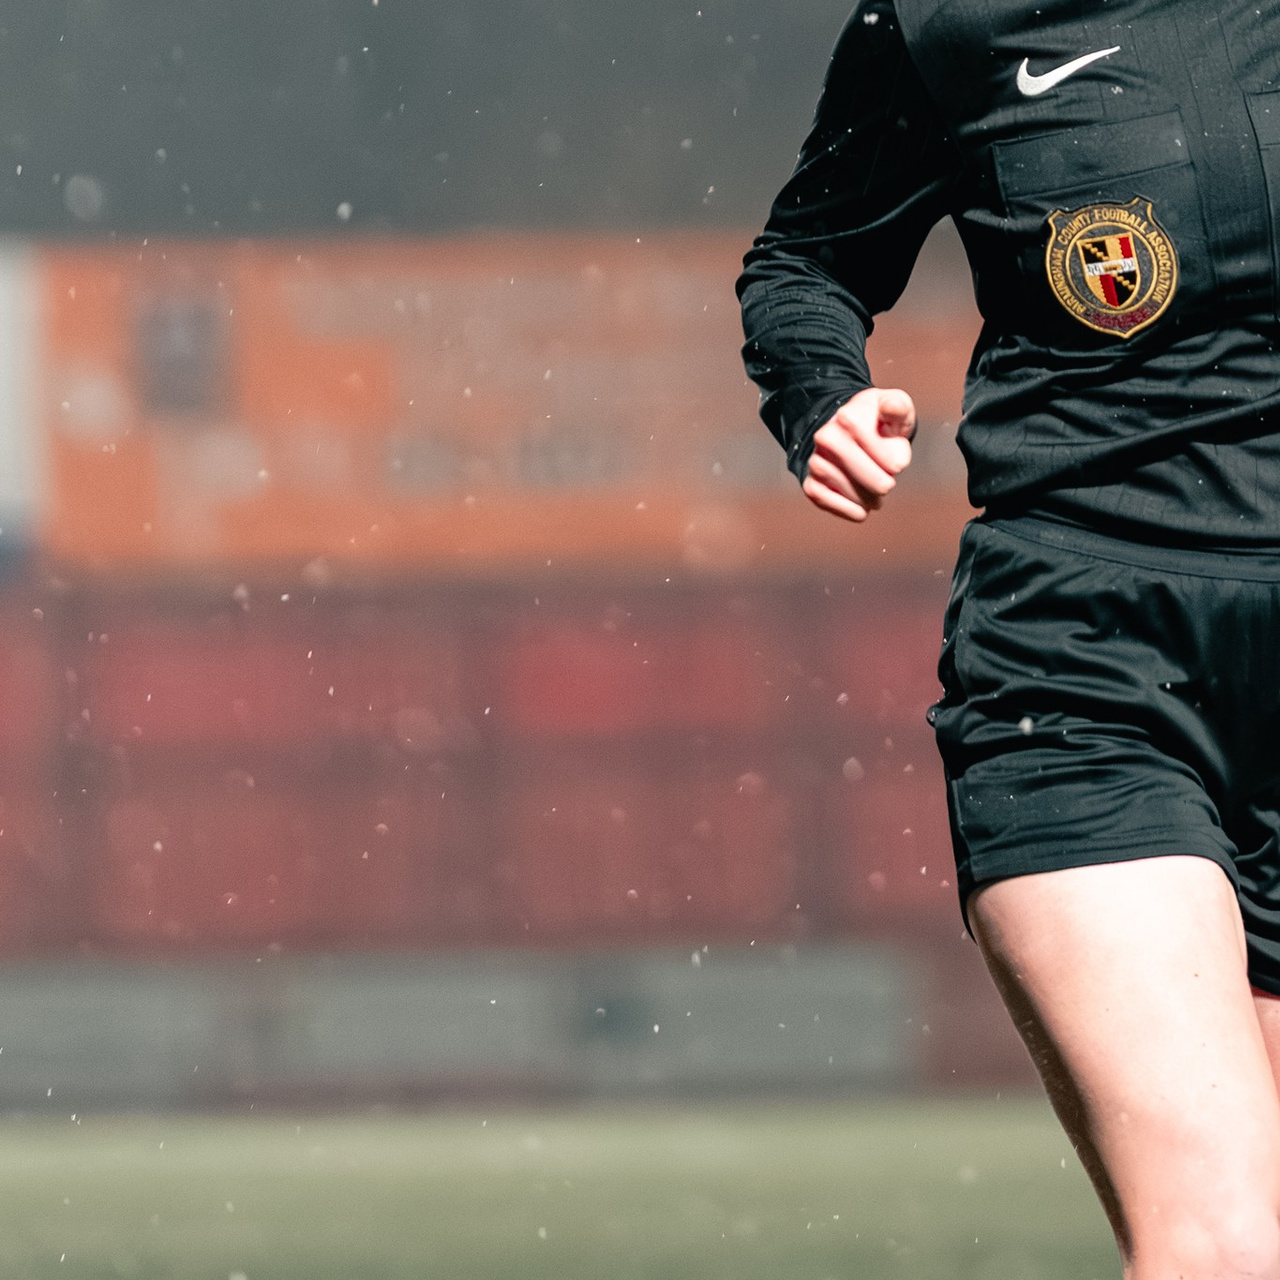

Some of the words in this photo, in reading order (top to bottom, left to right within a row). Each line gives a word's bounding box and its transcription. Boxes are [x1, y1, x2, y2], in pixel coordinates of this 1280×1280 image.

[1057, 211, 1091, 245] COUNTY
[1094, 208, 1148, 234] FOOTBALL
[1051, 247, 1087, 314] BIRMINGHAM
[1145, 231, 1174, 303] ASSOCIATION
